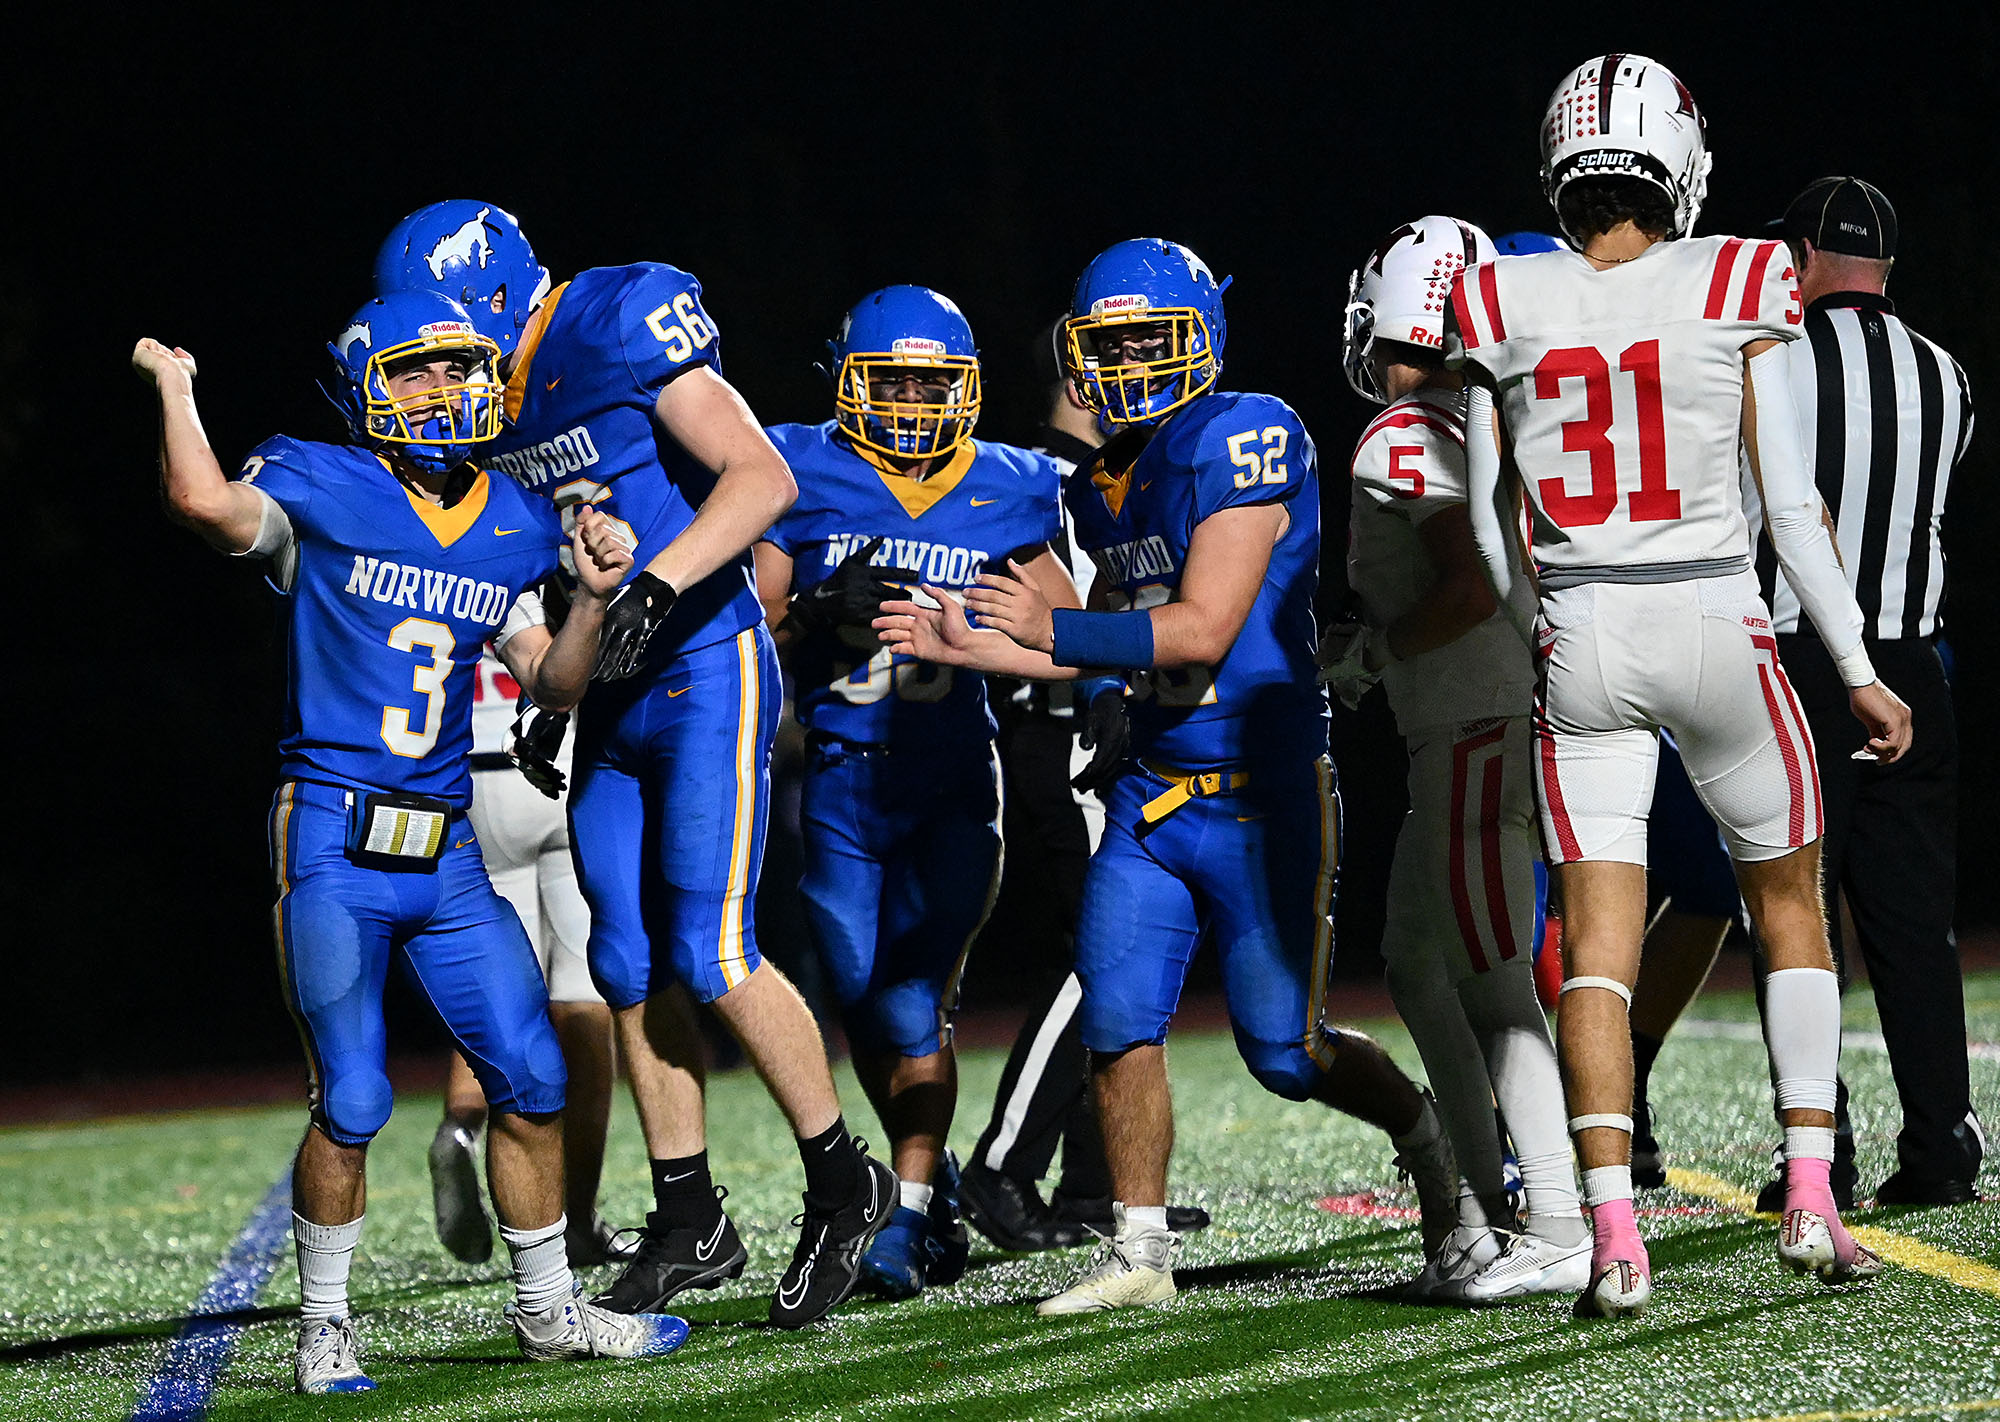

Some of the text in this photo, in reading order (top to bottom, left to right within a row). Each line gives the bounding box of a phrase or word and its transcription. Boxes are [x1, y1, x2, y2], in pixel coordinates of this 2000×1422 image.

[1577, 149, 1635, 168] schutt
[431, 323, 461, 332] Riddell
[644, 291, 713, 363] 56
[1104, 297, 1134, 309] Riddell
[904, 341, 934, 350] Riddell
[1226, 425, 1289, 489] 52
[1534, 339, 1680, 528] 31
[1388, 446, 1425, 499] 5
[345, 554, 509, 626] NORWOOD
[380, 616, 456, 759] 3
